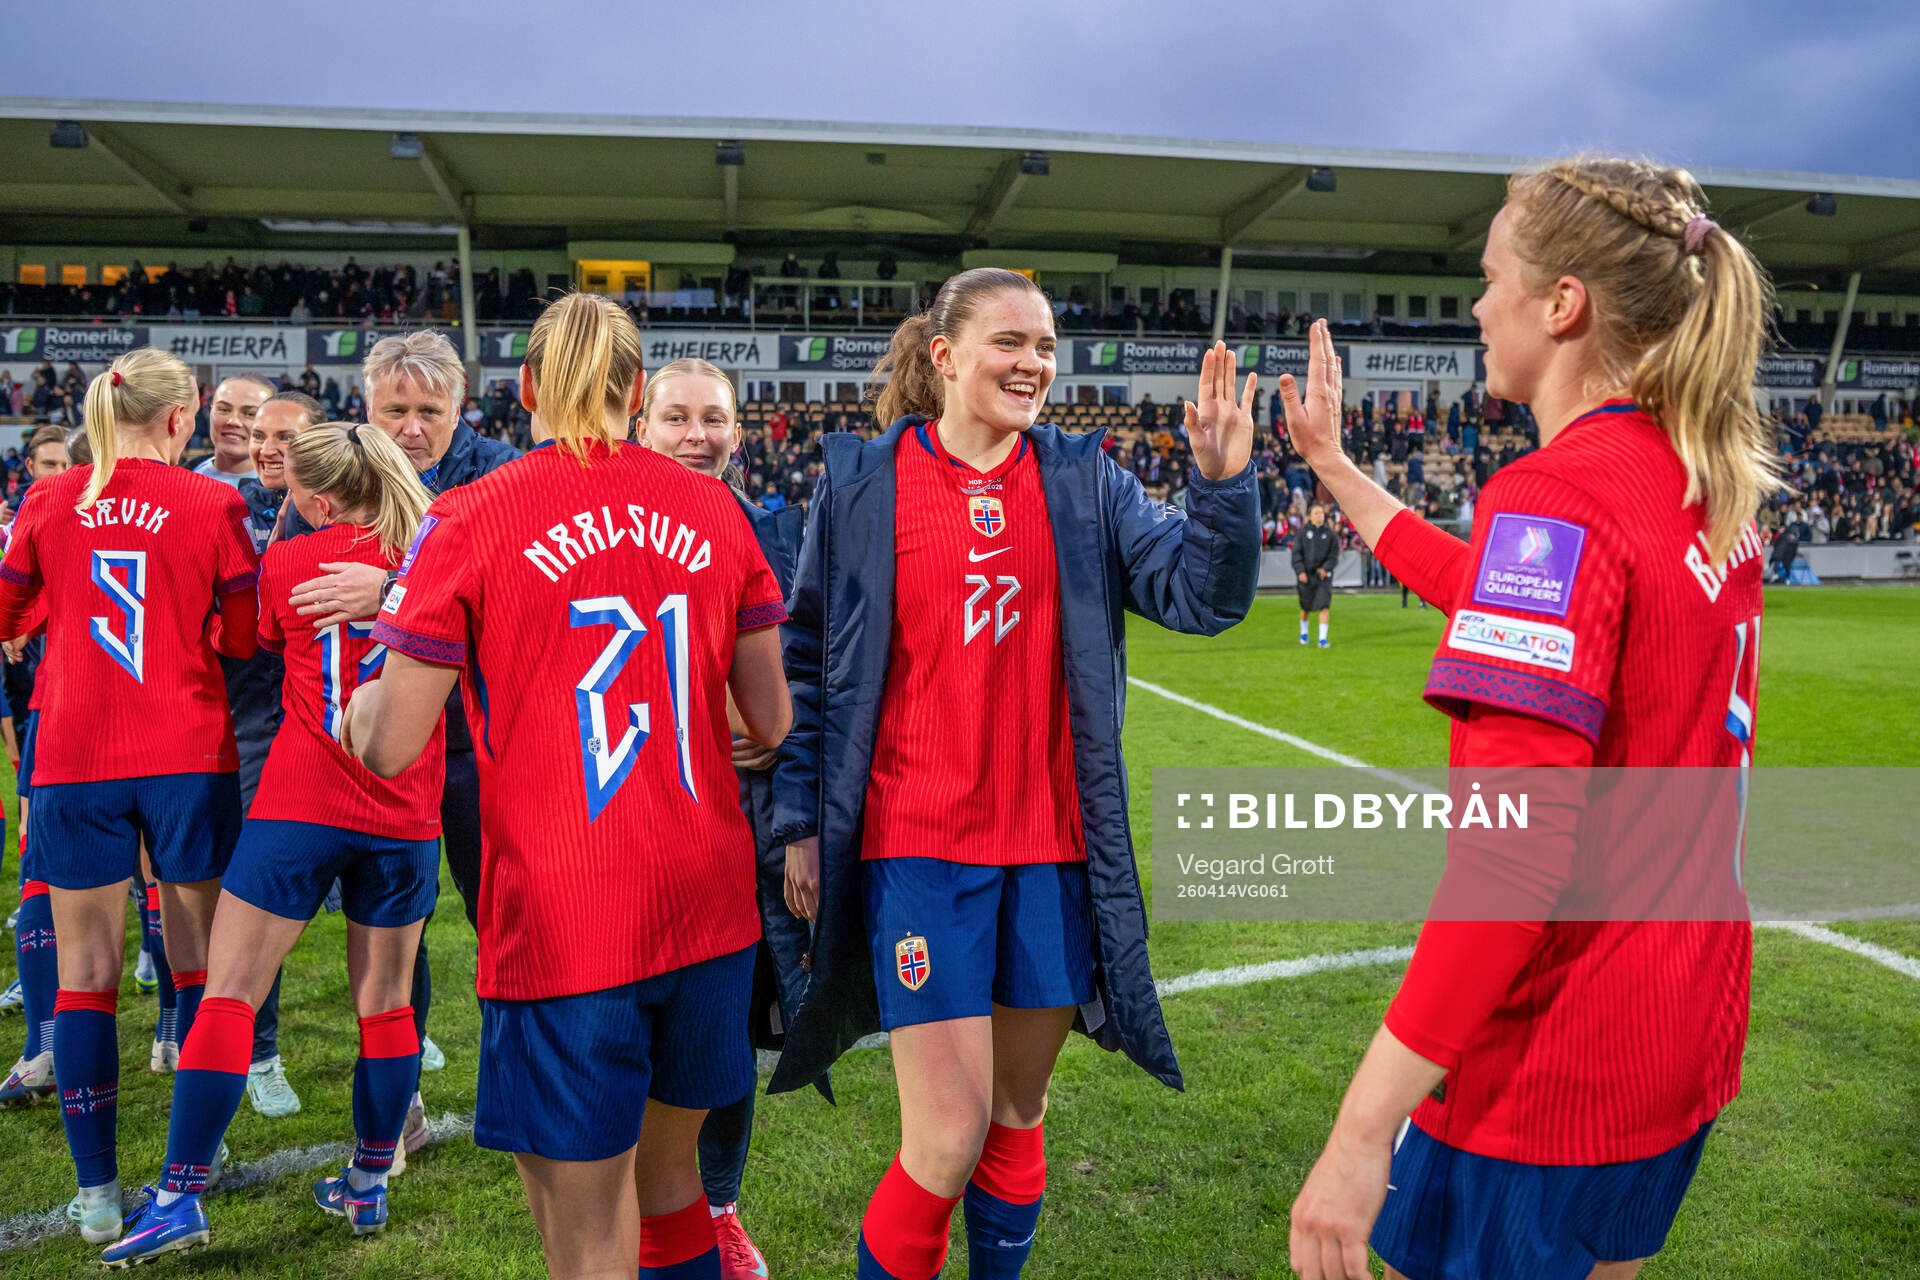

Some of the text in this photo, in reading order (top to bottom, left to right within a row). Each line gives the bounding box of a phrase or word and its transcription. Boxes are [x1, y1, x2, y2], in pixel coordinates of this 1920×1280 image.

[45, 327, 135, 344] Romerike
[170, 332, 287, 360] #HEIERPÅ
[833, 338, 891, 352] Romer
[43, 344, 126, 361] Spareba
[649, 337, 760, 364] #HEIERPÅ
[1123, 342, 1199, 358] Romerike
[1266, 344, 1309, 360] Rome
[1122, 358, 1198, 374] Sparebank
[1366, 351, 1459, 376] #HEIERPÅ
[74, 497, 170, 535] SÆVIK
[1488, 570, 1563, 591] EUROPEAN
[1484, 582, 1562, 602] QUALIFIERS
[964, 574, 1022, 646] 22
[1457, 623, 1571, 655] FOUNDATION
[569, 593, 699, 824] 21
